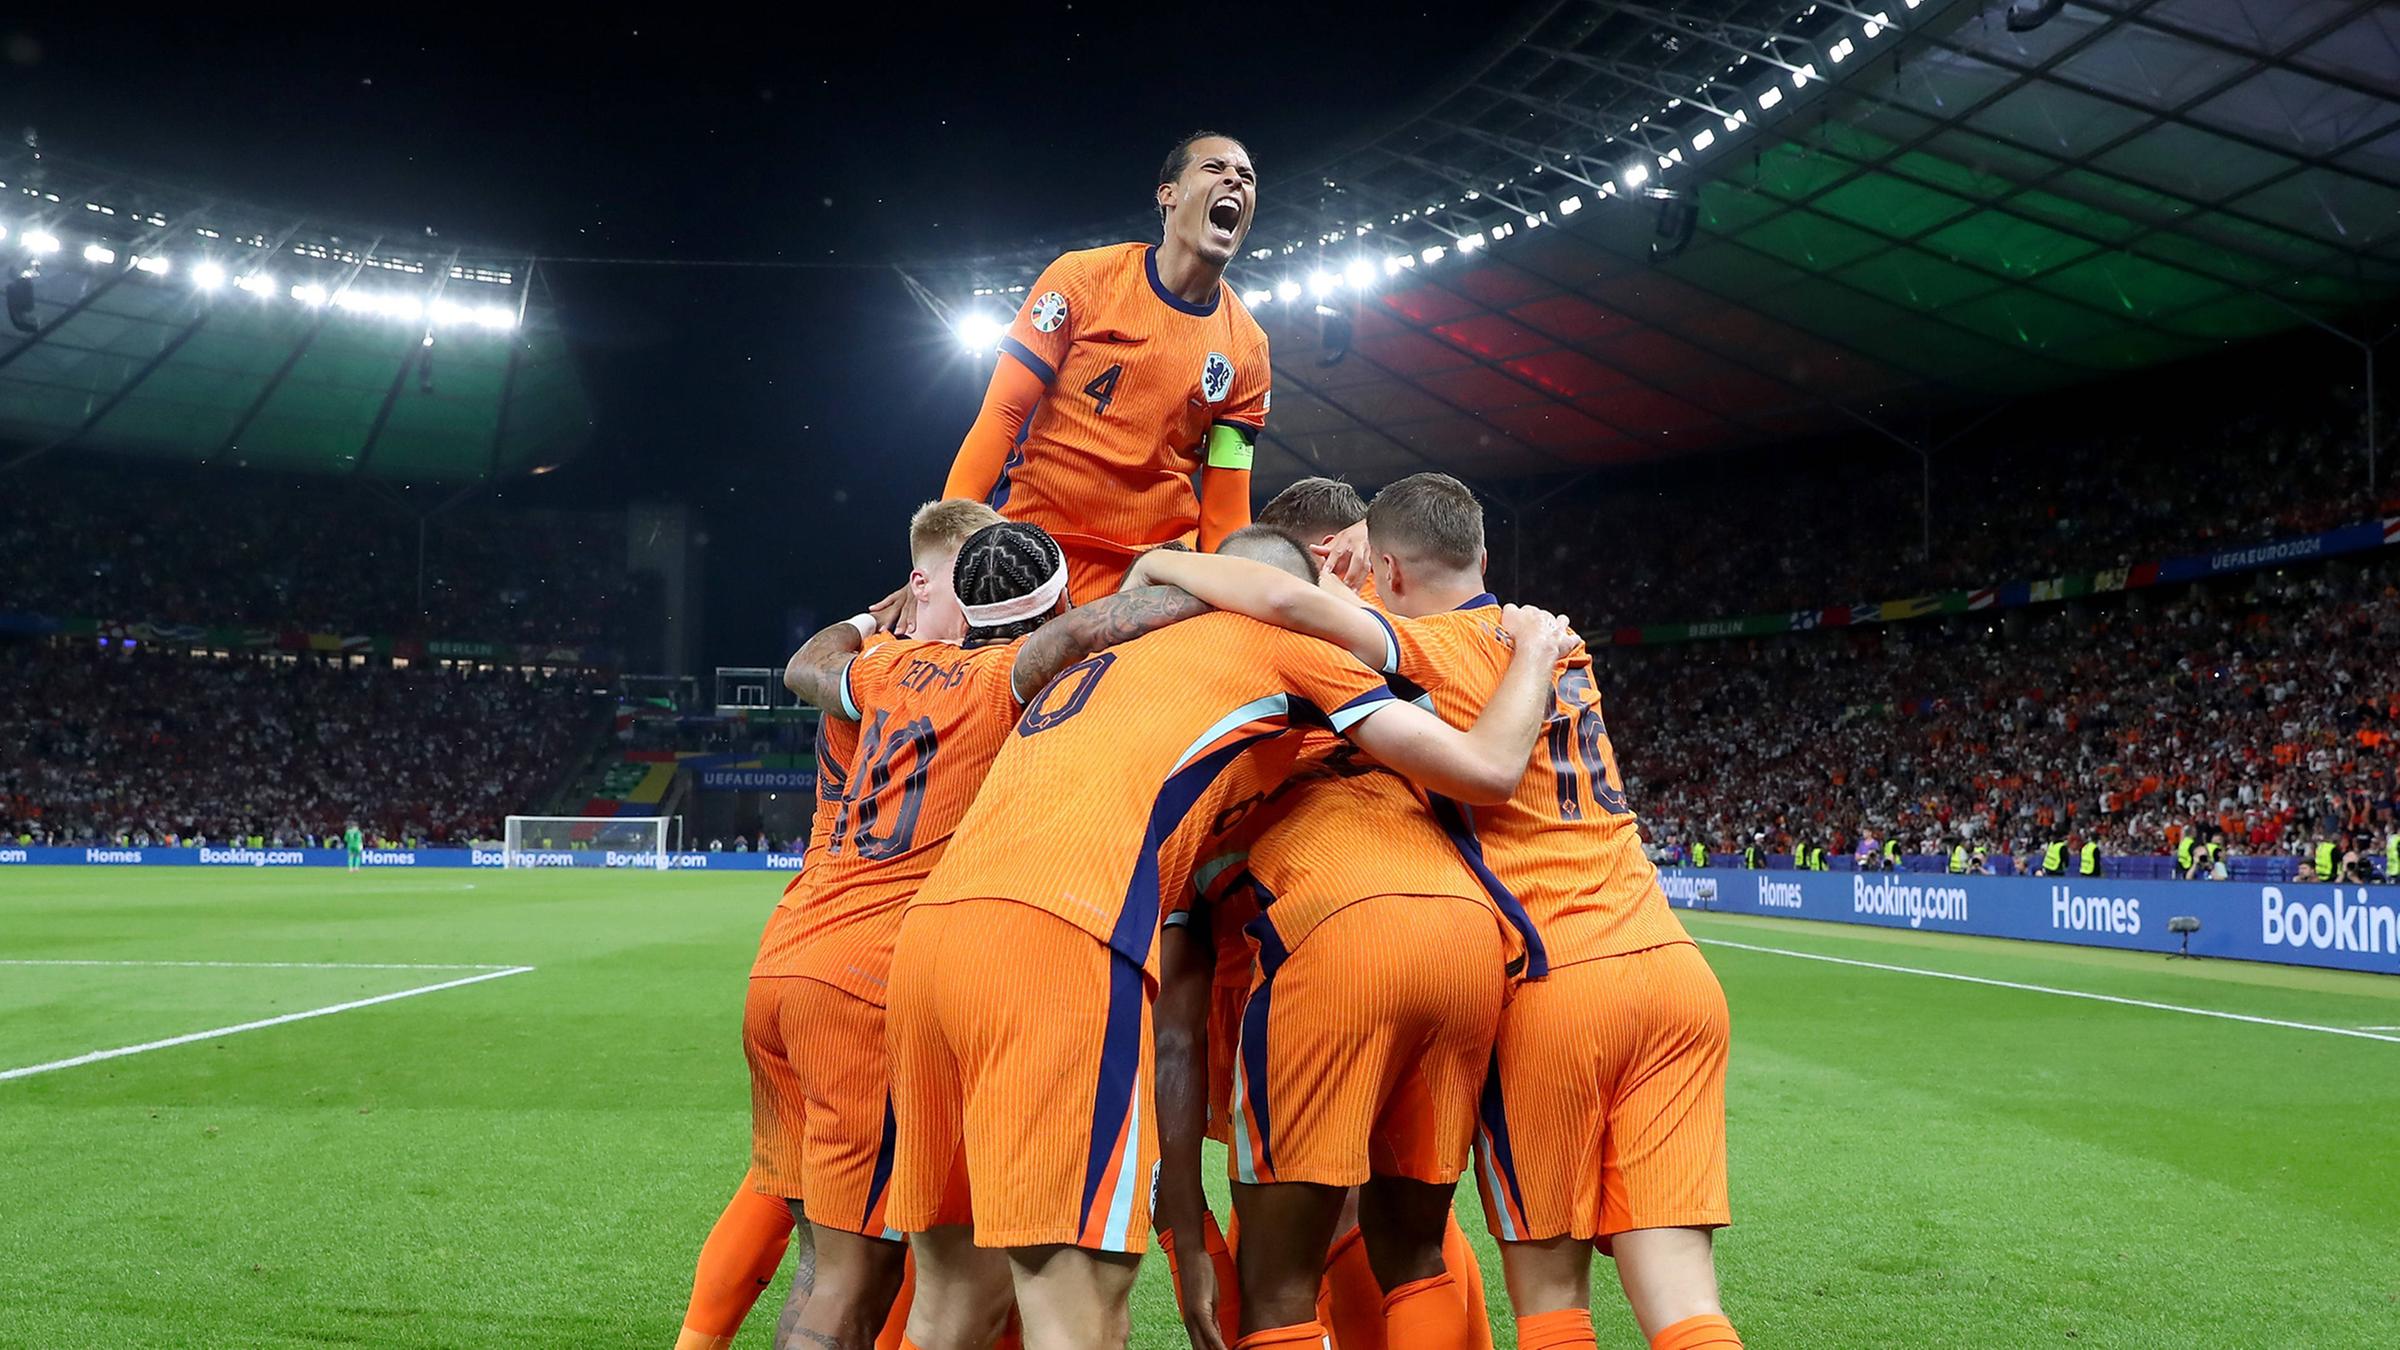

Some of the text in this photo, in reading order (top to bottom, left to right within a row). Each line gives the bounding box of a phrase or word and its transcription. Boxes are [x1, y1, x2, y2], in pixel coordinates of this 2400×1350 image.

[1083, 363, 1123, 416] 4
[429, 641, 492, 656] BERLIN
[1688, 621, 1744, 637] BERLIN
[1545, 667, 1630, 821] 16
[830, 708, 938, 861] 10
[86, 848, 142, 863] Homes
[200, 848, 304, 866] Booking.com
[361, 850, 415, 864] Homes
[1758, 875, 1802, 908] Homes
[1853, 874, 1968, 928] Booking.com
[2052, 885, 2141, 935] Homes
[2262, 886, 2400, 955] Bookin
